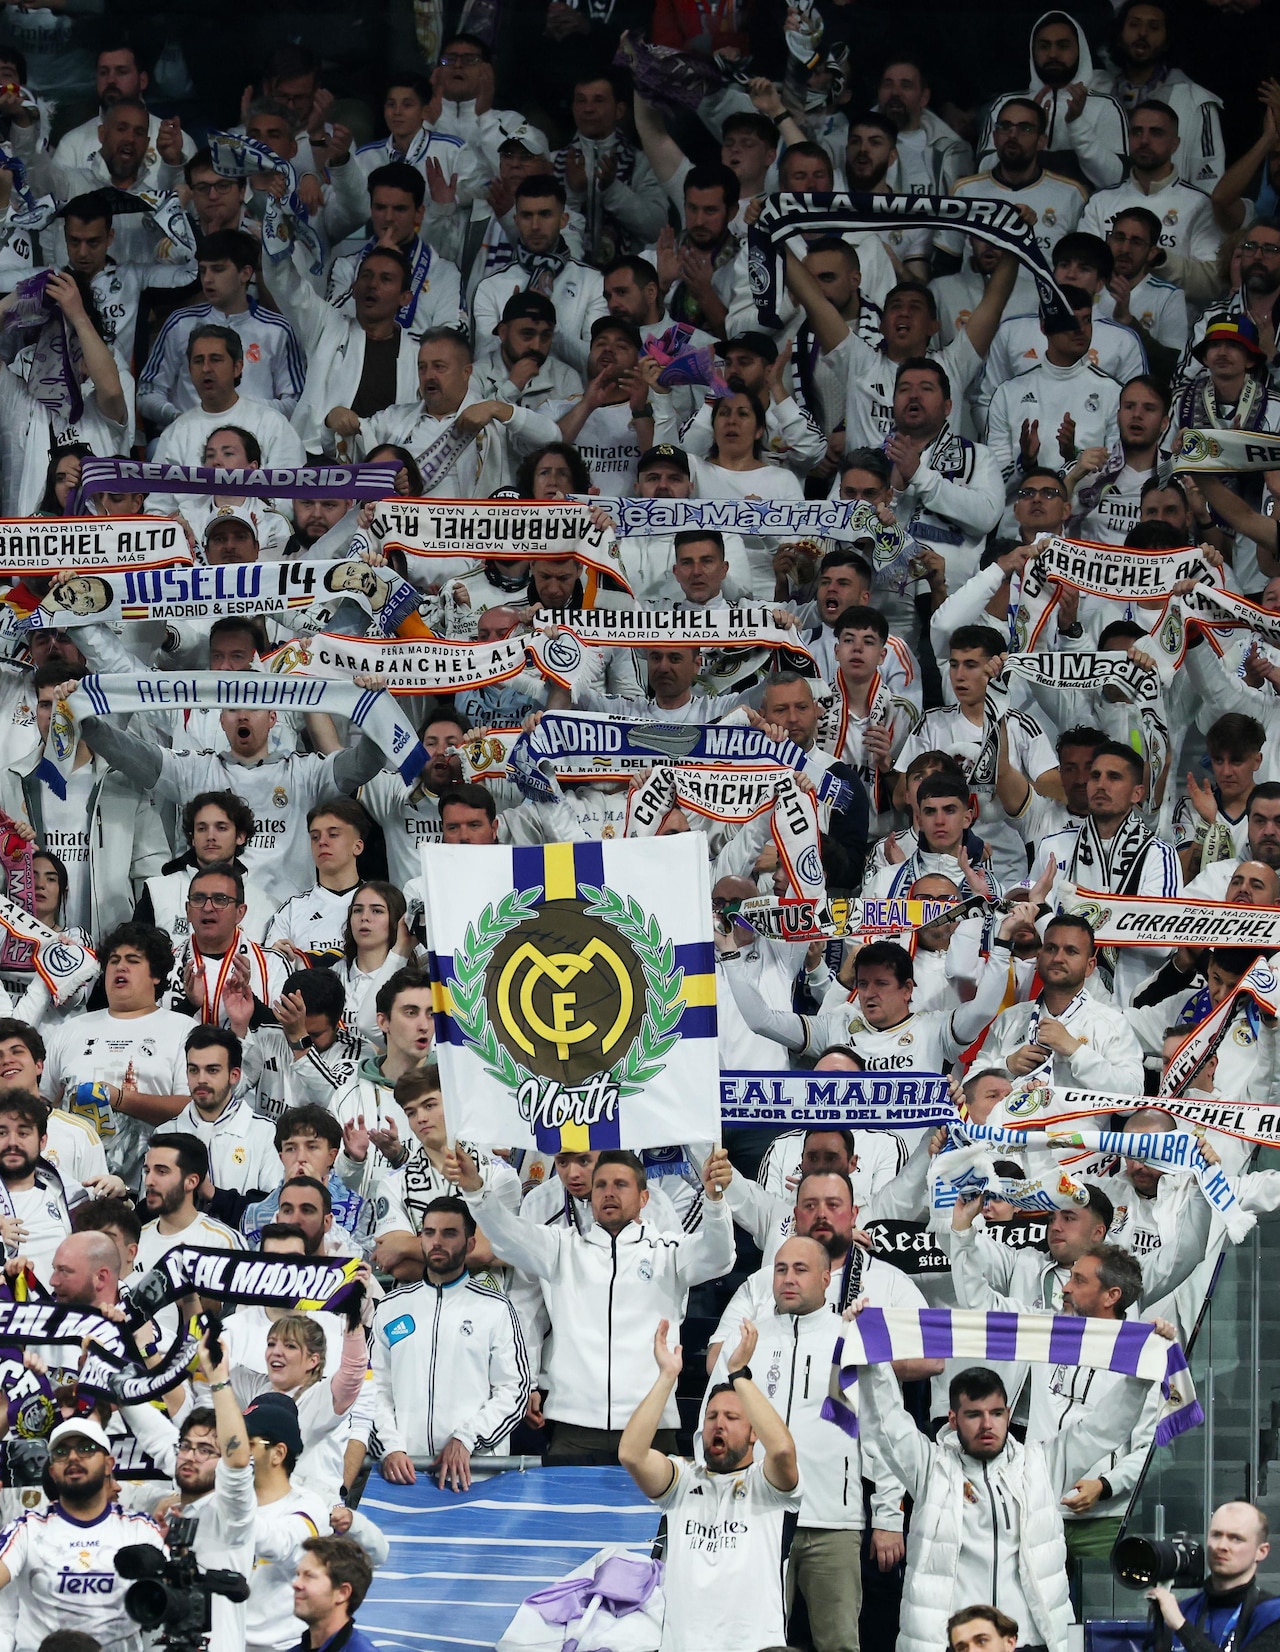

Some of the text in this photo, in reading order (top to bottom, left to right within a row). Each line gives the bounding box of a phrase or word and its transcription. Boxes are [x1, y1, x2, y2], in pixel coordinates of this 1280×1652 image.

[758, 192, 851, 224] HALA
[118, 462, 354, 487] REAL MADRID
[428, 507, 465, 515] NADA
[473, 507, 479, 515] Y
[487, 507, 539, 517] MADRID
[548, 507, 582, 515] HALA
[699, 500, 847, 529] Madrid
[29, 524, 114, 533] MADRIDISTA
[371, 514, 419, 540] ALTO
[117, 527, 176, 553] ALTO
[422, 541, 504, 550] MADRIDISTA
[56, 558, 65, 566] Y
[72, 556, 110, 565] NADA
[117, 552, 146, 564] MÁS
[1053, 539, 1176, 566] PEÑA MADRIDISTA
[121, 562, 316, 605] JOSELU 14
[1130, 586, 1167, 596] NADA
[152, 597, 284, 619] MADRID & ESPAÑA
[574, 629, 600, 639] ALA
[607, 629, 660, 639] MADRID
[667, 630, 675, 639] Y
[682, 629, 720, 639] NADA
[319, 650, 476, 673] CARABANCHEL
[381, 646, 474, 656] PEÑA MADRIDISTA
[448, 672, 482, 684] NADA
[1035, 673, 1056, 687] Real
[1057, 678, 1093, 688] Madrid
[136, 679, 327, 706] REAL MADRID
[531, 719, 622, 754] MADRID
[621, 759, 648, 768] DEL
[776, 777, 809, 836] ALTO
[4, 902, 53, 939] ALTO
[863, 901, 912, 926] REAL
[1183, 908, 1215, 916] PEÑA
[1117, 913, 1278, 938] CARABANCHEL
[1137, 933, 1167, 941] HALA
[1173, 934, 1219, 942] MADRID
[517, 1070, 617, 1136] North
[720, 1079, 792, 1106] EAL
[721, 1107, 955, 1120] MEJOR CLUB DEL MUNDO
[1099, 1131, 1190, 1166] VILLALBA
[869, 1223, 935, 1253] Rea
[165, 1247, 344, 1301] REAL MADRID
[684, 1519, 748, 1538] Emirates
[69, 1540, 100, 1548] KELME
